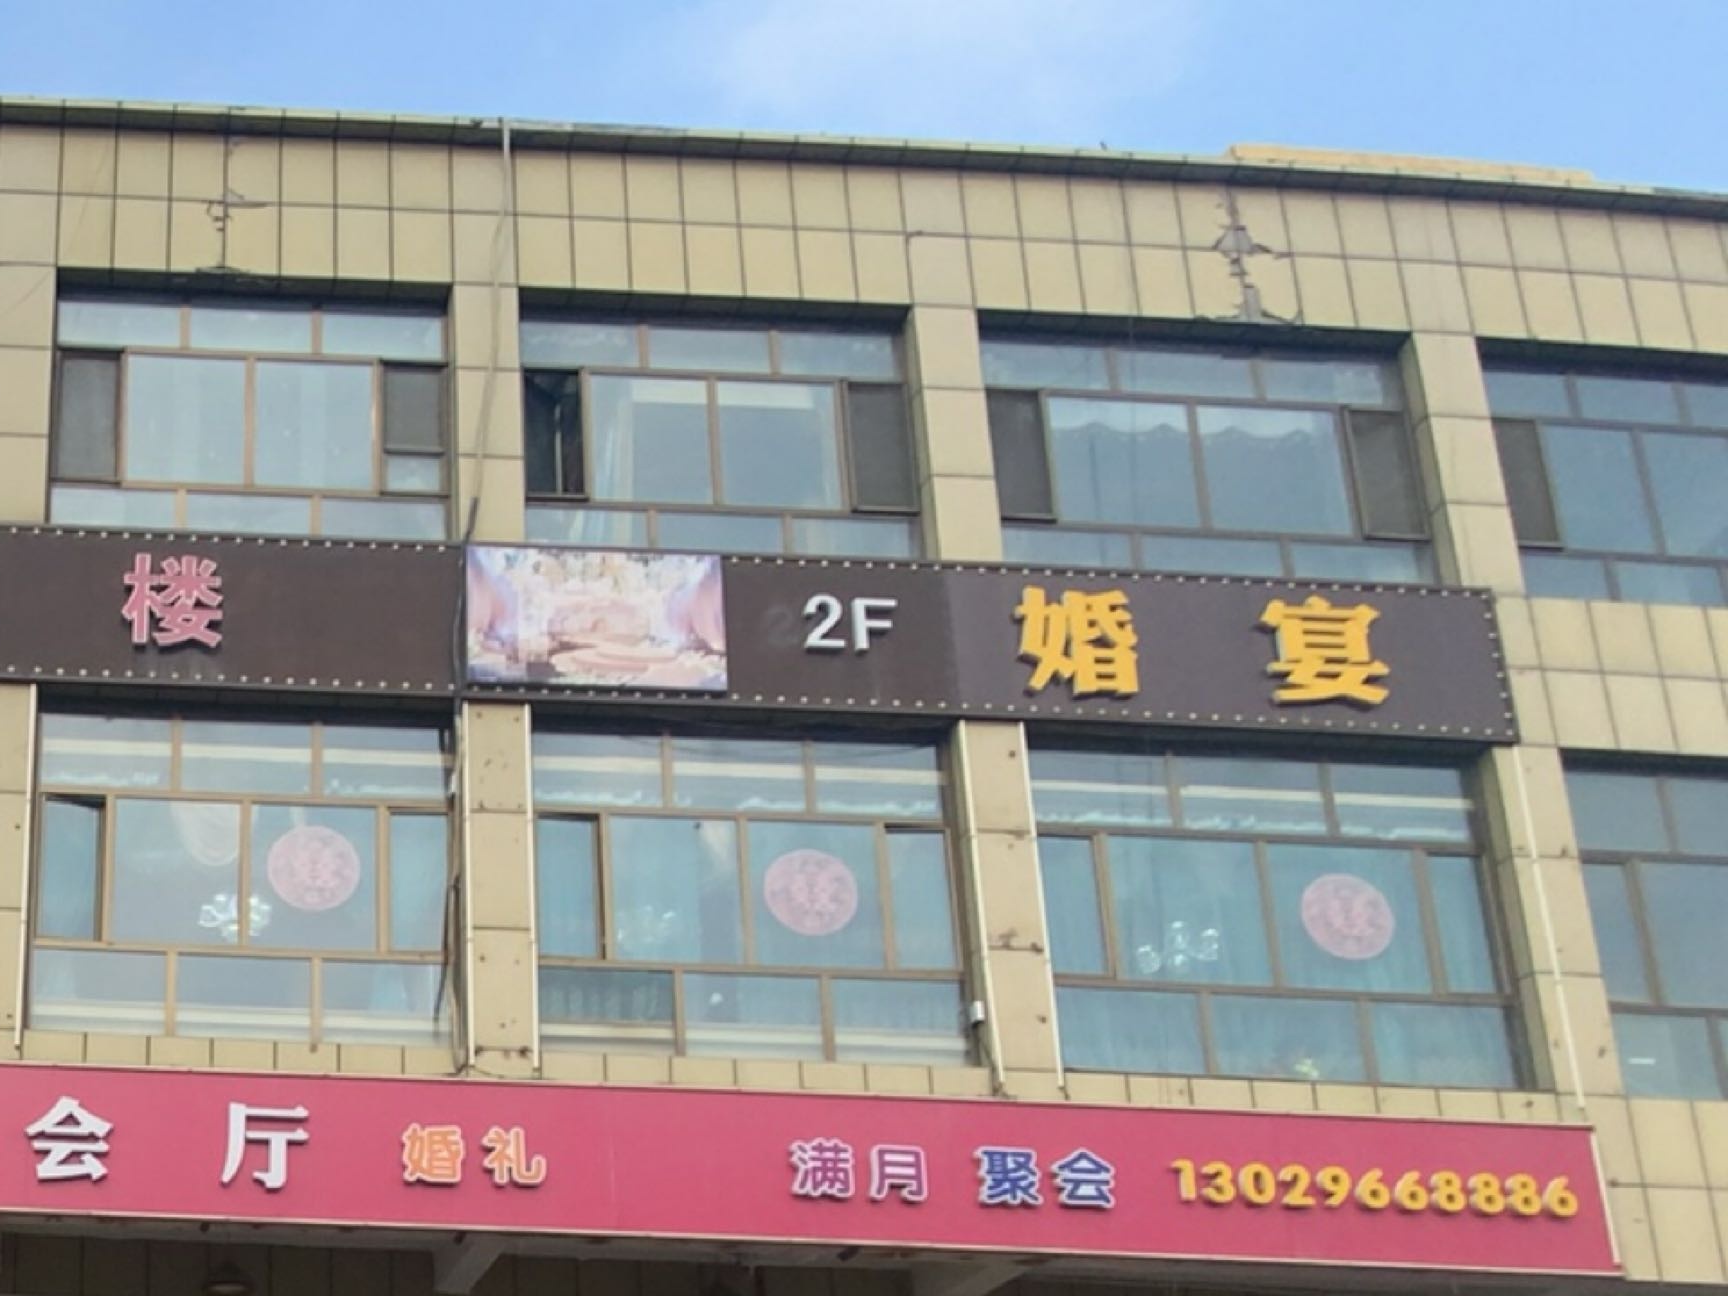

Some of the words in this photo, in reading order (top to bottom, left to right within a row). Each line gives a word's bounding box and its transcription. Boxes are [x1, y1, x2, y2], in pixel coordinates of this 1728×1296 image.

[802, 594, 898, 654] 2F
[1015, 584, 1392, 707] 婚宴
[403, 1123, 548, 1188] 婚礼
[789, 1139, 928, 1202] 满月
[975, 1145, 1117, 1209] 聚会
[1172, 1158, 1580, 1219] 13029668886
